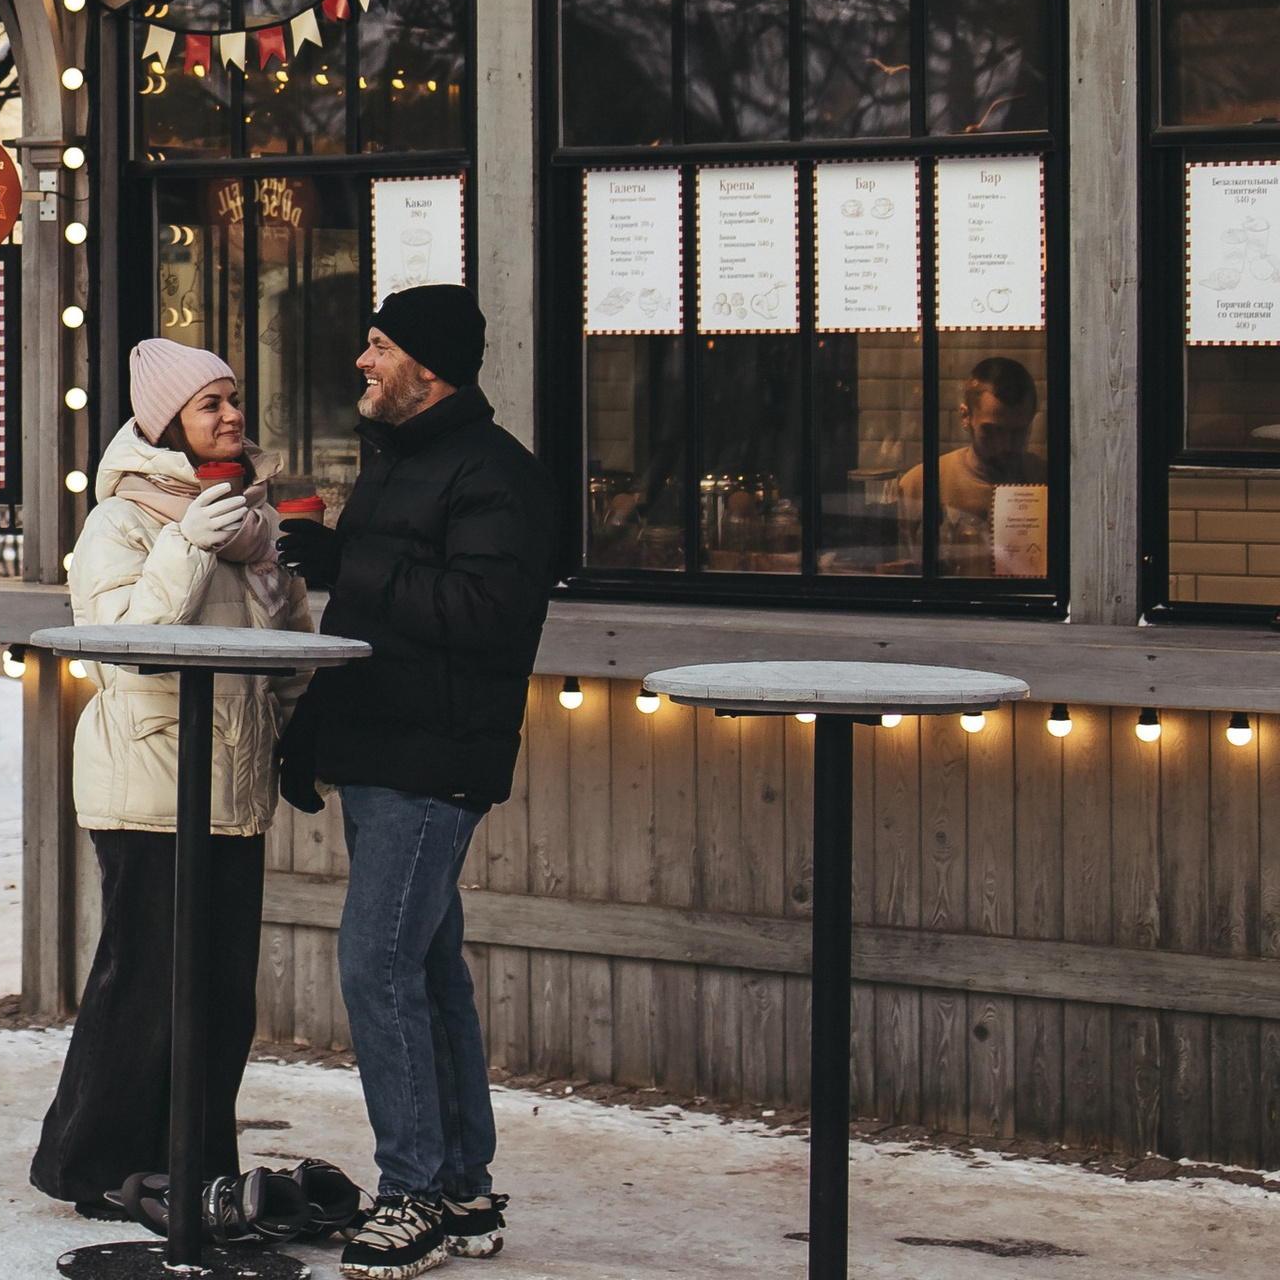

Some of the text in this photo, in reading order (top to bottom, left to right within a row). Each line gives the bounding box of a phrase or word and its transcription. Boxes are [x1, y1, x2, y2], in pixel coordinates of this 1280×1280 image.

[980, 170, 1002, 186] Бар
[1211, 177, 1279, 187] Безалкогольный
[610, 182, 646, 194] Галеты
[719, 179, 755, 194] Крепы
[855, 177, 876, 193] Бар
[1224, 187, 1268, 196] глинтвейн
[405, 197, 432, 208] Какао
[1250, 197, 1256, 205] р
[1216, 299, 1274, 310] Горячий сидр
[1229, 311, 1271, 319] специями
[1251, 323, 1257, 331] р
